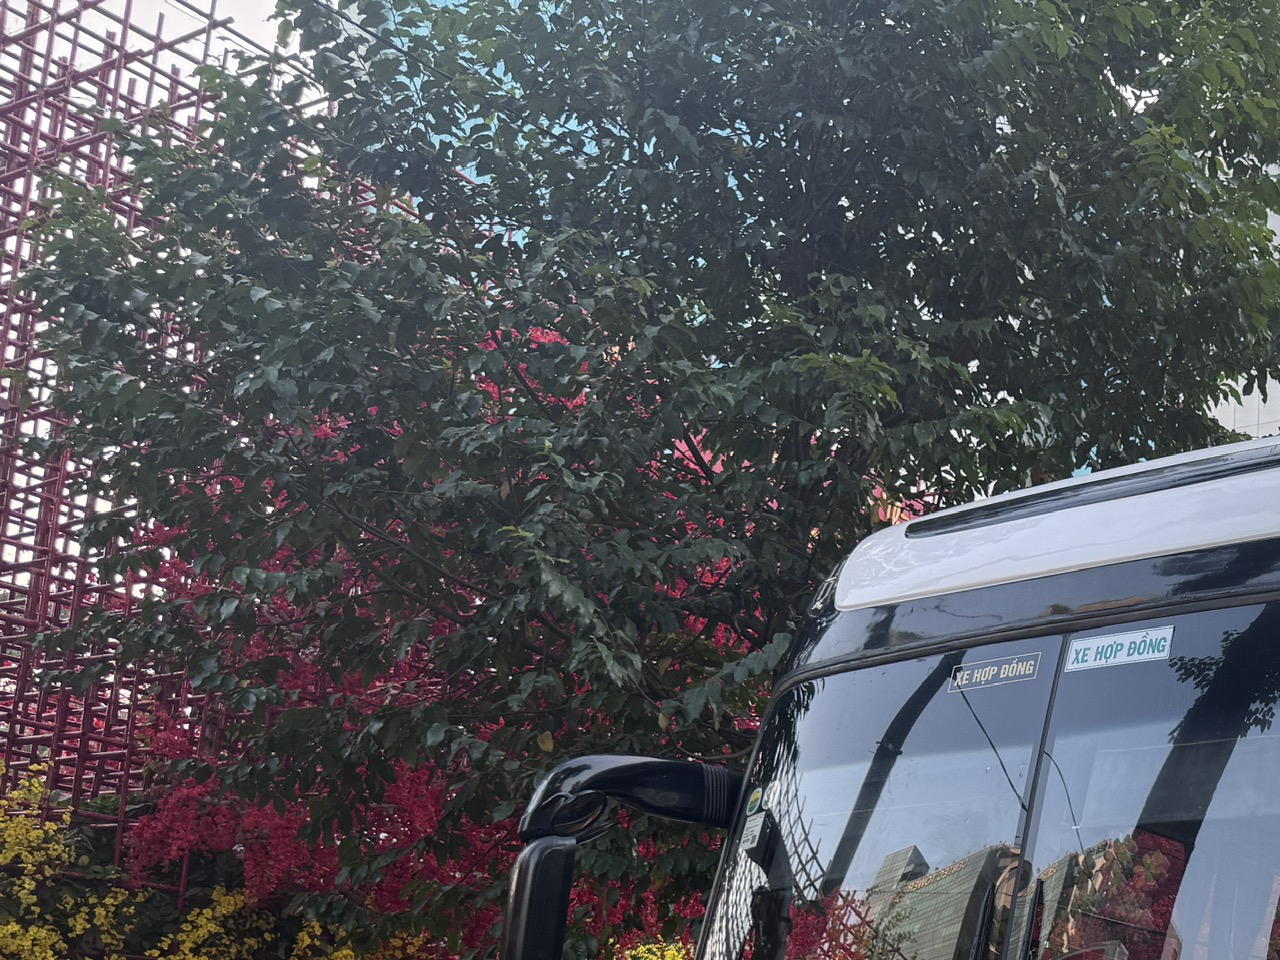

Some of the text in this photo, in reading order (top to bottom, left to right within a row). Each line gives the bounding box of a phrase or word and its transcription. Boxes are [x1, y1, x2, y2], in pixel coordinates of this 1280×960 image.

[1071, 632, 1168, 666] XE HỢP ĐỒNG
[953, 658, 1035, 687] XE HỢP ĐỒNG
